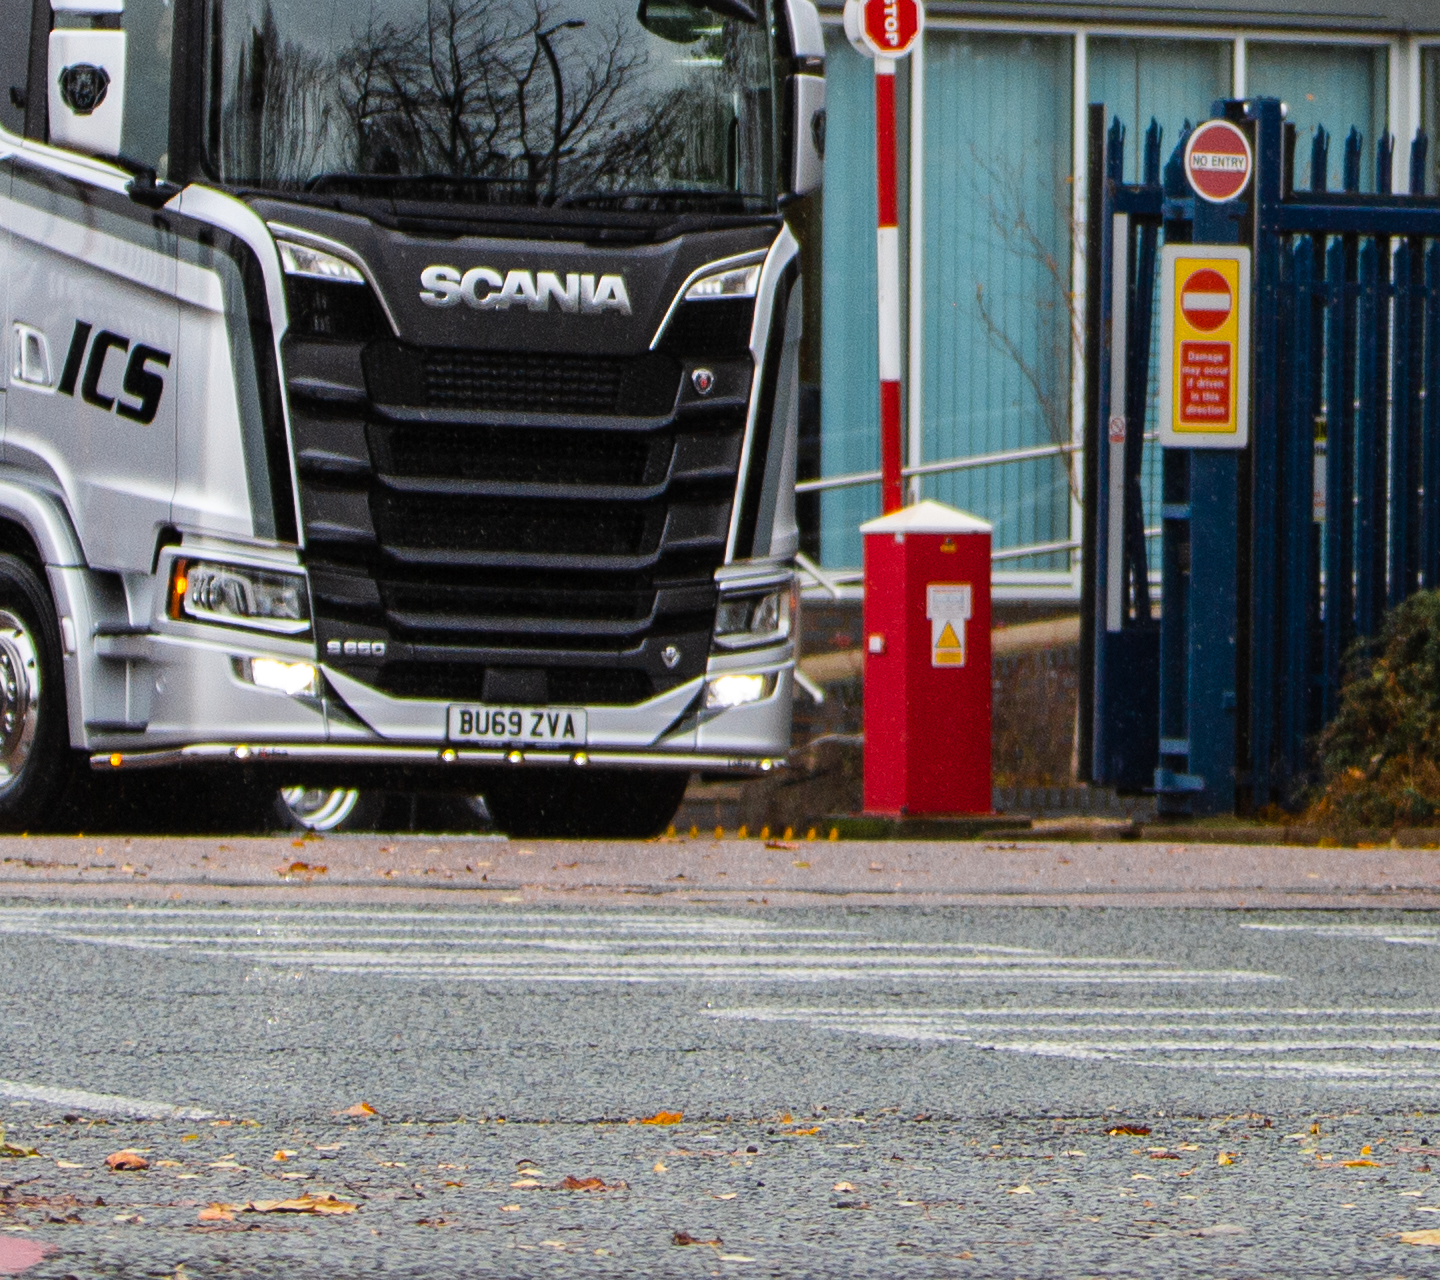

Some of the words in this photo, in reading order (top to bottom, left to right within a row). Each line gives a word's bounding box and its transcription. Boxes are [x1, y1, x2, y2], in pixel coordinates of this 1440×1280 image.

[1192, 155, 1208, 167] NO
[1211, 156, 1245, 169] ENTRY
[419, 264, 633, 316] SCANIA
[1188, 351, 1224, 365] Damage
[57, 318, 172, 426] ICS
[1185, 403, 1225, 416] direction
[459, 709, 522, 736] BU69
[530, 712, 575, 738] ZVA
